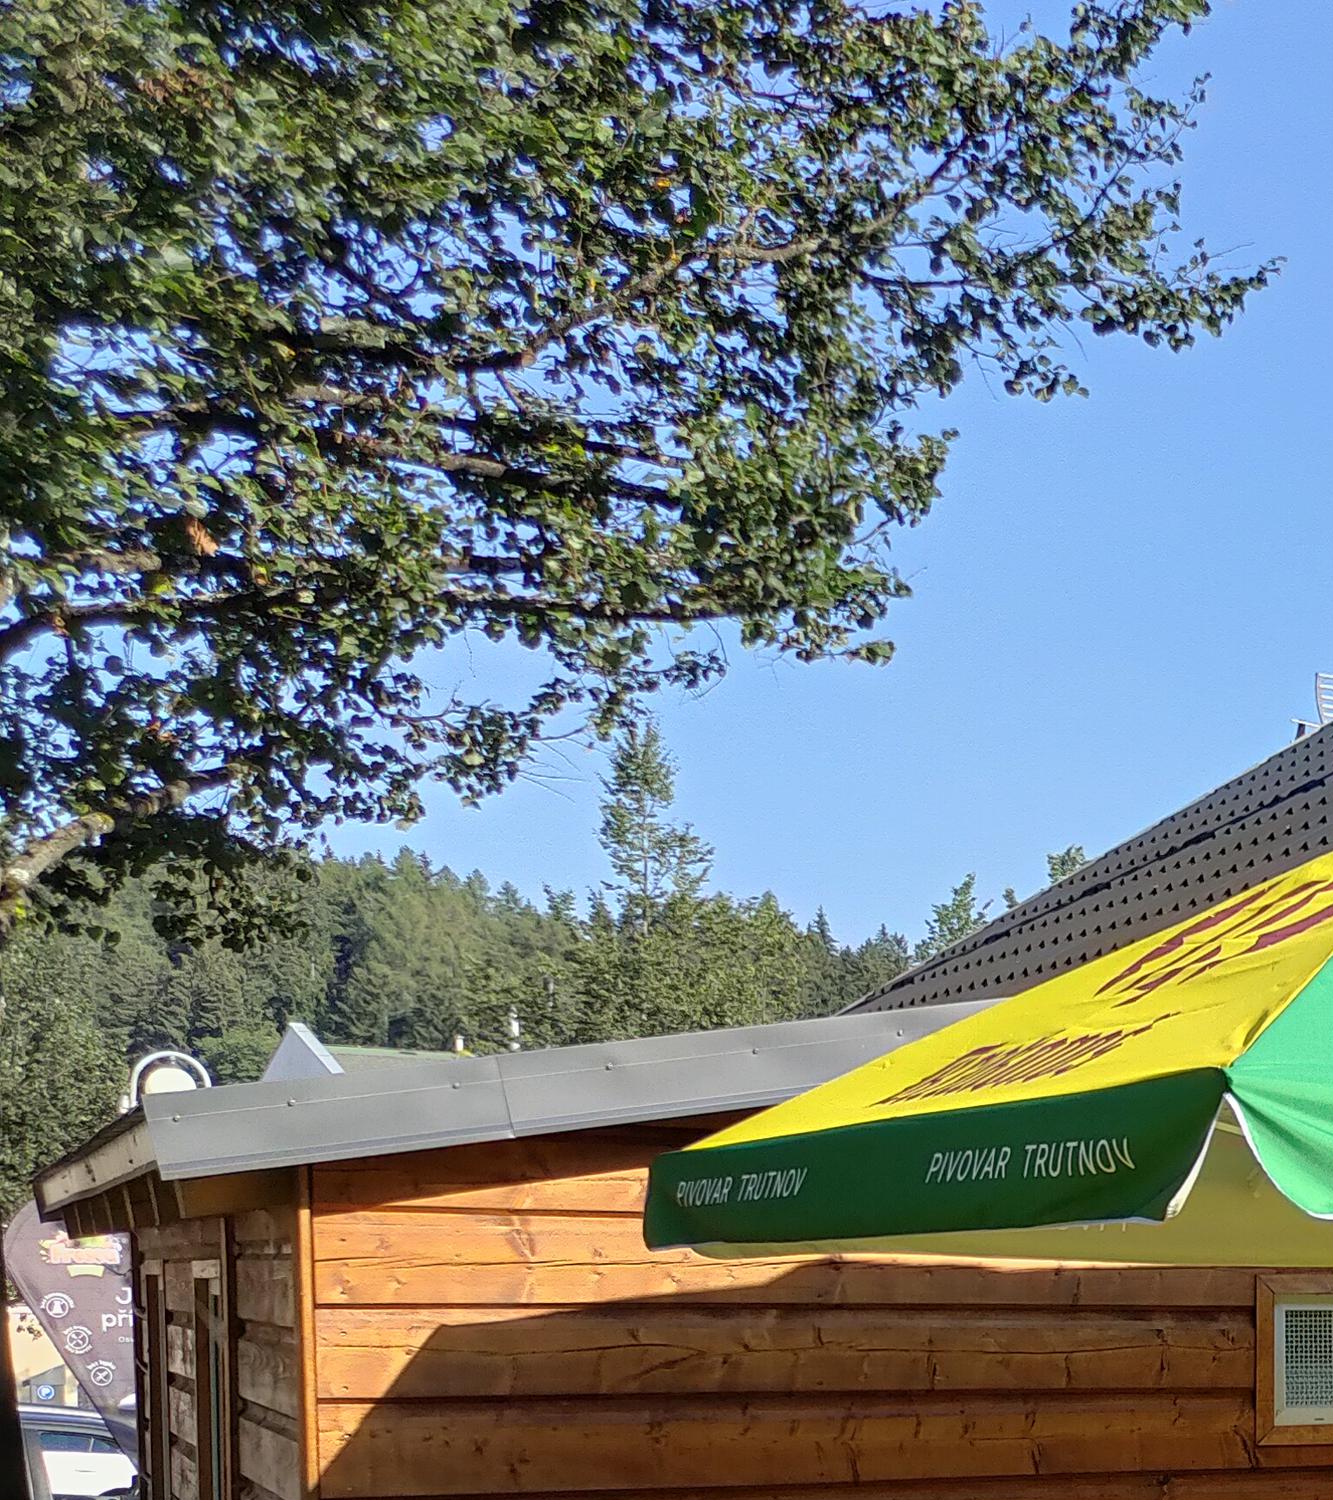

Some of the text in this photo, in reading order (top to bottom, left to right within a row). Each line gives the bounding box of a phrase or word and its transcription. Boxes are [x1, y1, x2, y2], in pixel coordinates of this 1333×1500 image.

[925, 1137, 1136, 1184] PIVOVAR TRUTNOV
[677, 1167, 808, 1207] PIVOVAR TRUTNOV
